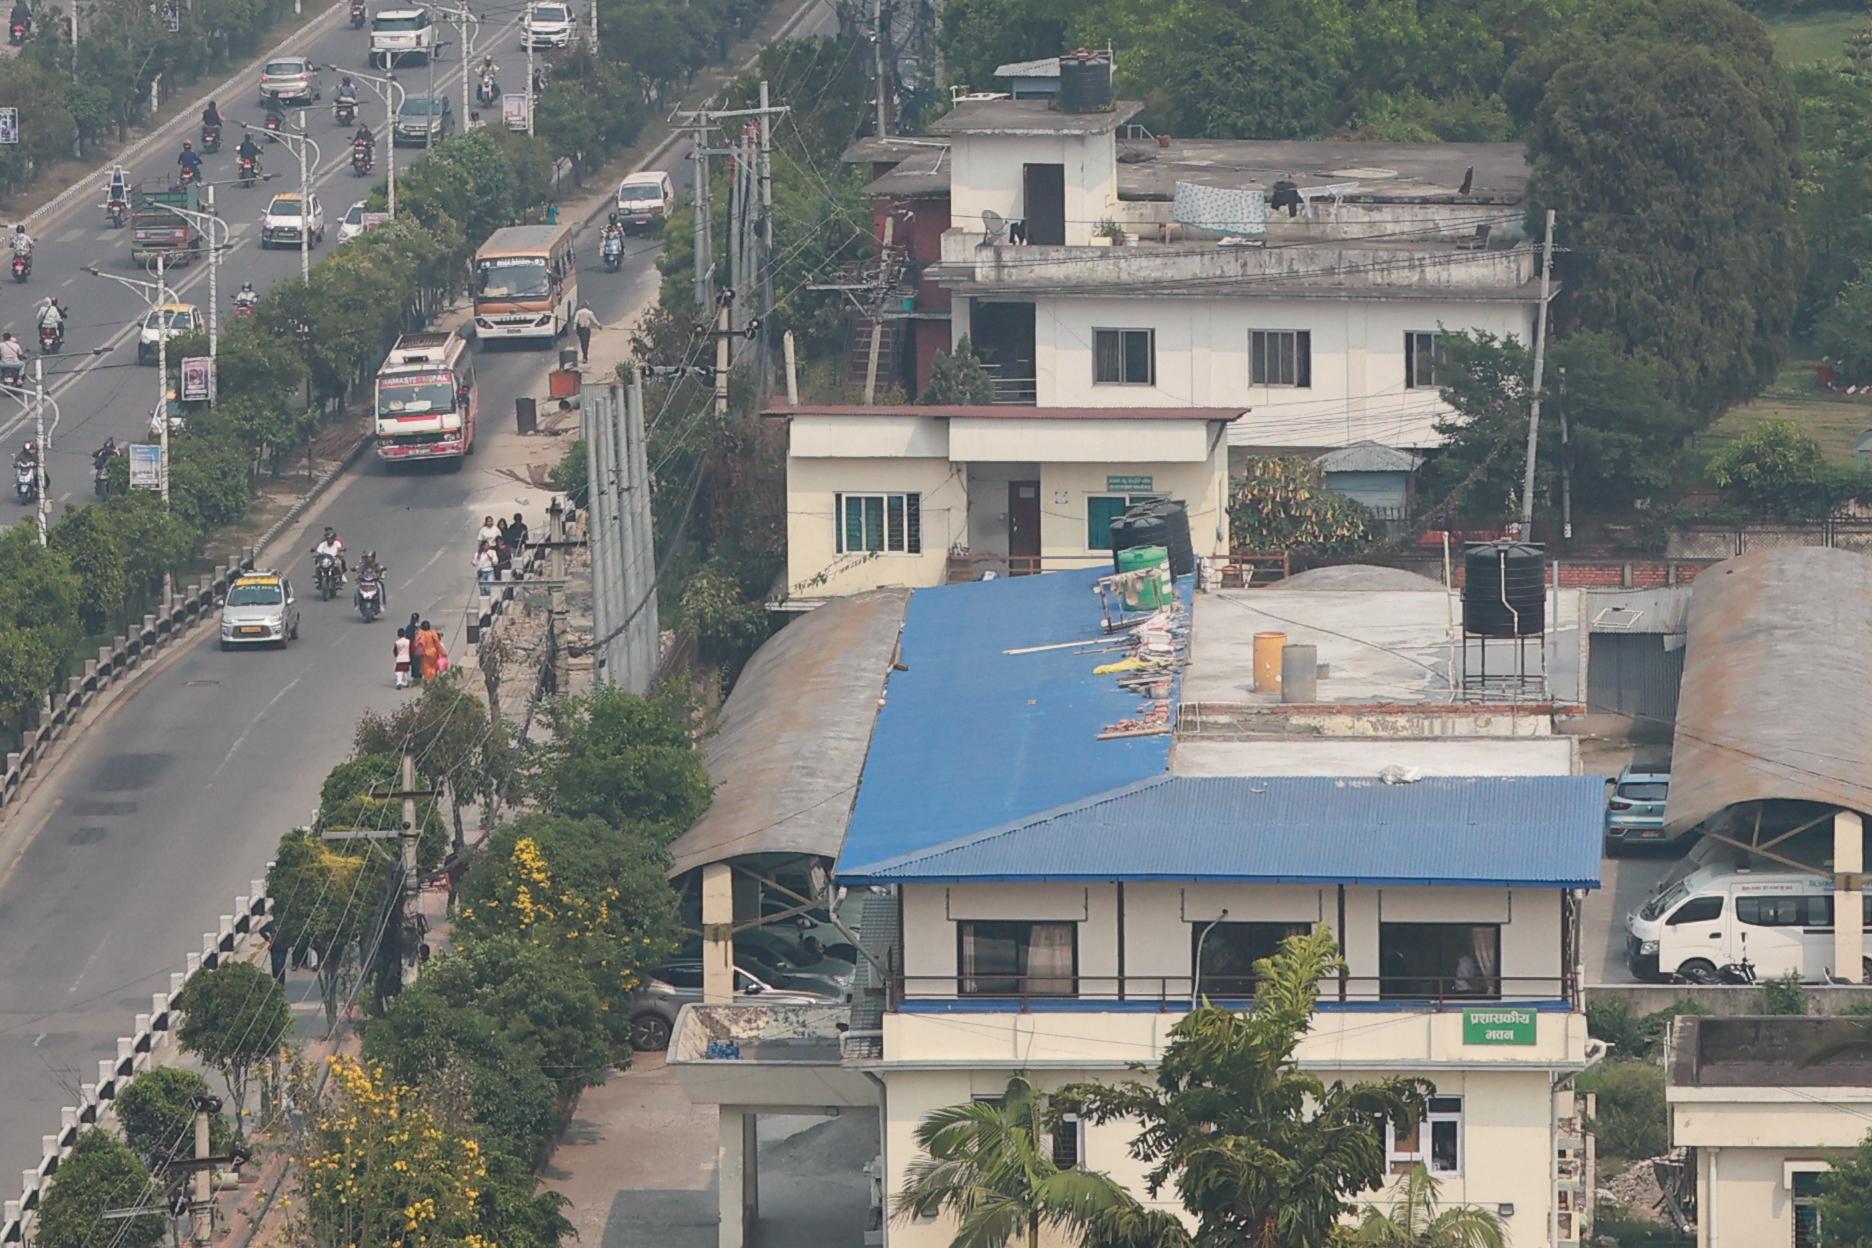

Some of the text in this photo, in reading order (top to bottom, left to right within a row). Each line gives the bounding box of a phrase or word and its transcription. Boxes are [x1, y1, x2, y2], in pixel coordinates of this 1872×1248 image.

[418, 374, 448, 384] PAL
[1470, 1010, 1530, 1025] प्रशासकीय
[1484, 1030, 1515, 1040] भवन
